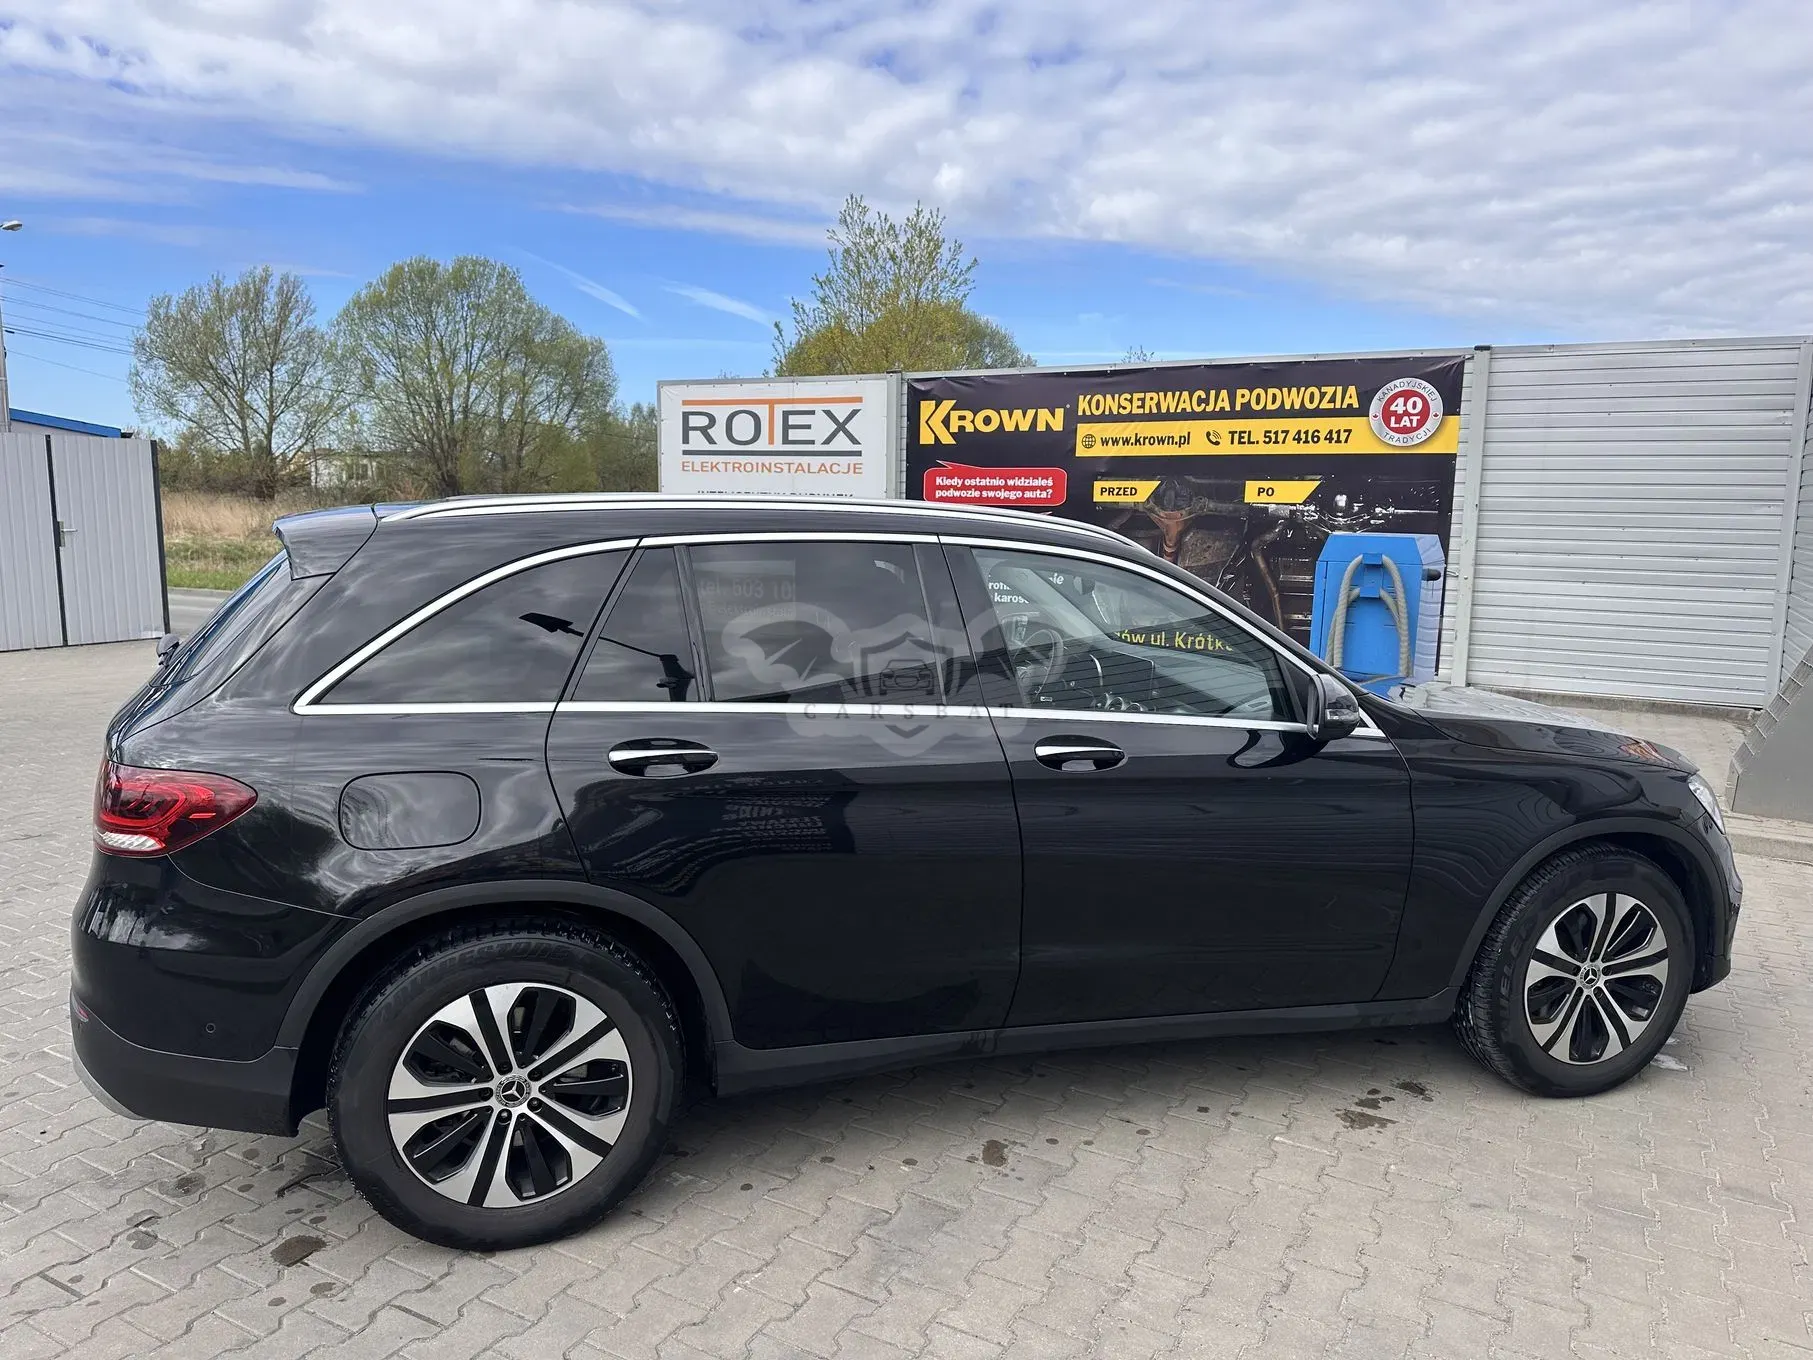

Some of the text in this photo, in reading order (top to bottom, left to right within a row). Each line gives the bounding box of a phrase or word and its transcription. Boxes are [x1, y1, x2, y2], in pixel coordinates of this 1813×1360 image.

[1377, 380, 1438, 402] KANADYJSKIEJ
[1077, 385, 1360, 416] KONSERWACJA PODWOZIA
[1389, 396, 1423, 414] 40
[681, 396, 863, 446] ROTEX
[919, 399, 1065, 445] KROWN
[1389, 415, 1421, 428] LAT
[1100, 428, 1353, 448] www.krown.pl TEL. 517 416 417
[1383, 427, 1432, 444] TRADYCJI
[681, 461, 863, 475] ELEKTROINSTALACJE
[935, 476, 963, 489] Kiedy
[964, 476, 1005, 487] ostatnio
[935, 488, 1053, 500] podwozie swojego auta?
[1100, 486, 1138, 497] PRZED
[1257, 487, 1275, 497] PO
[1150, 631, 1170, 647] ul.
